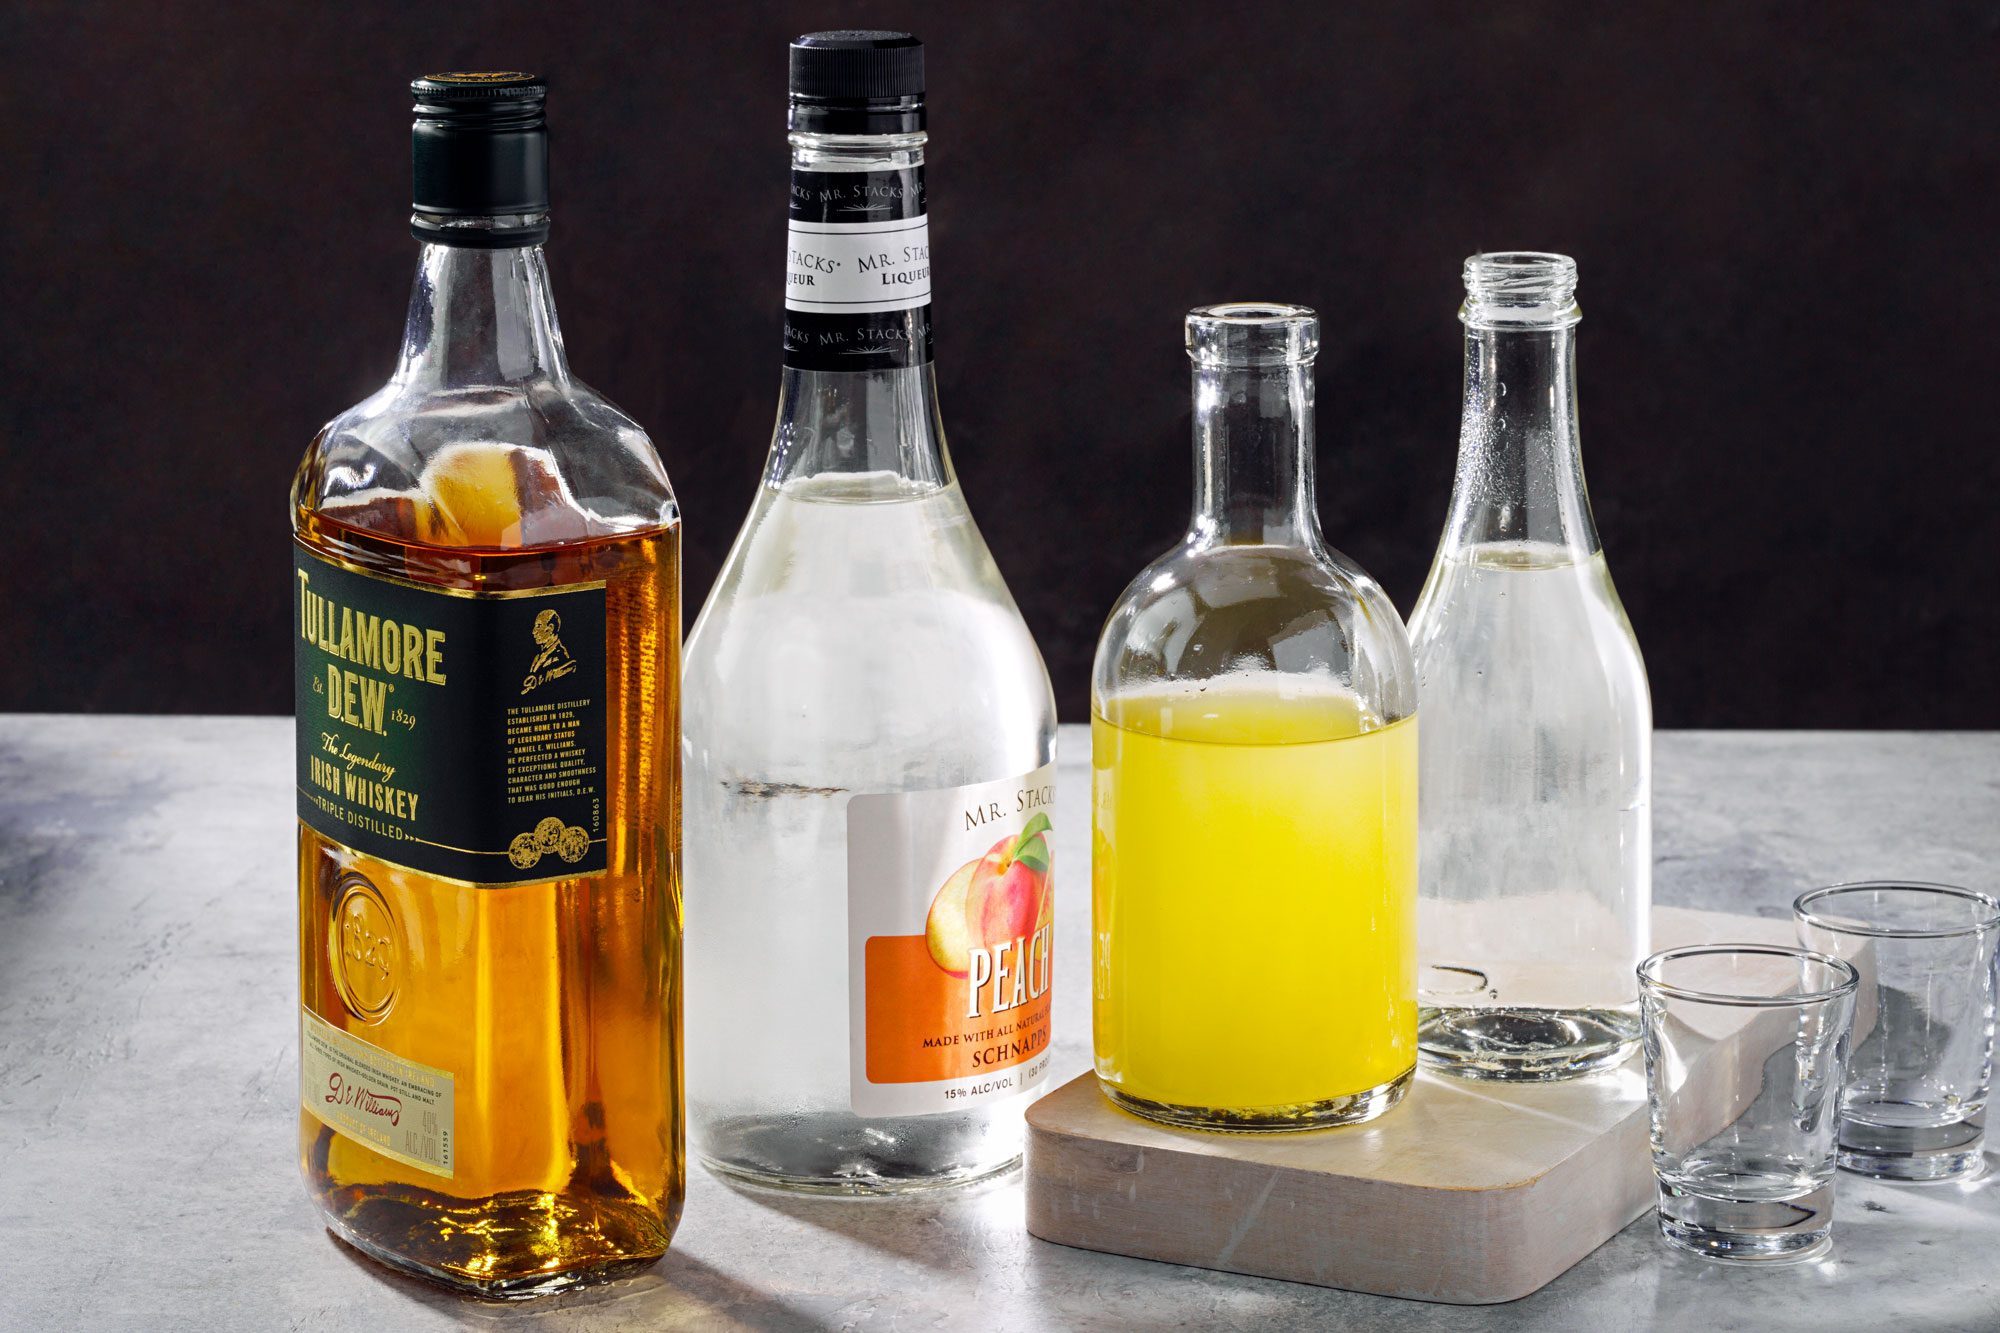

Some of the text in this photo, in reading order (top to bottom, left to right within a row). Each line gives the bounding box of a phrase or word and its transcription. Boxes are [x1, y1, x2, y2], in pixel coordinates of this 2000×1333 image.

[820, 189, 846, 203] MR.
[853, 185, 903, 199] STACKS
[858, 254, 895, 274] MR.
[903, 246, 929, 263] STAC
[820, 332, 849, 346] MR.
[298, 567, 447, 686] TULLAMORE
[521, 703, 555, 714] TULLAMORE
[557, 699, 591, 709] DISTILLERY
[391, 708, 416, 731] 1829
[507, 714, 548, 726] ESTABLISHED
[507, 726, 532, 736] BECAME
[534, 724, 551, 732] HOME
[567, 720, 581, 728] MAN
[517, 734, 552, 744] LEGENDARY
[554, 731, 575, 740] STATUS
[321, 731, 397, 783] The Legendary
[514, 745, 535, 754] DANIEL
[517, 753, 552, 764] PERFECTED
[560, 748, 586, 758] WHISKEY
[507, 766, 597, 784] CHARACTER AND SMOOTHNESS
[518, 762, 558, 773] EXCEPTIONAL
[310, 754, 419, 822] IRISH WHISKEY
[507, 778, 581, 794] THAT WAS GOOD ENOUGH
[517, 794, 534, 803] BEAR
[535, 792, 546, 800] HIS
[317, 795, 403, 841] TRIPLE DISTILLED
[965, 802, 1007, 831] MR.
[966, 923, 1050, 1018] PEACH
[922, 1011, 1045, 1048] MADE WITH ALL NATURAL
[972, 1025, 1047, 1068] SCHNAPPS
[944, 1088, 967, 1099] 15%
[971, 1077, 1013, 1096] ALC/VOL
